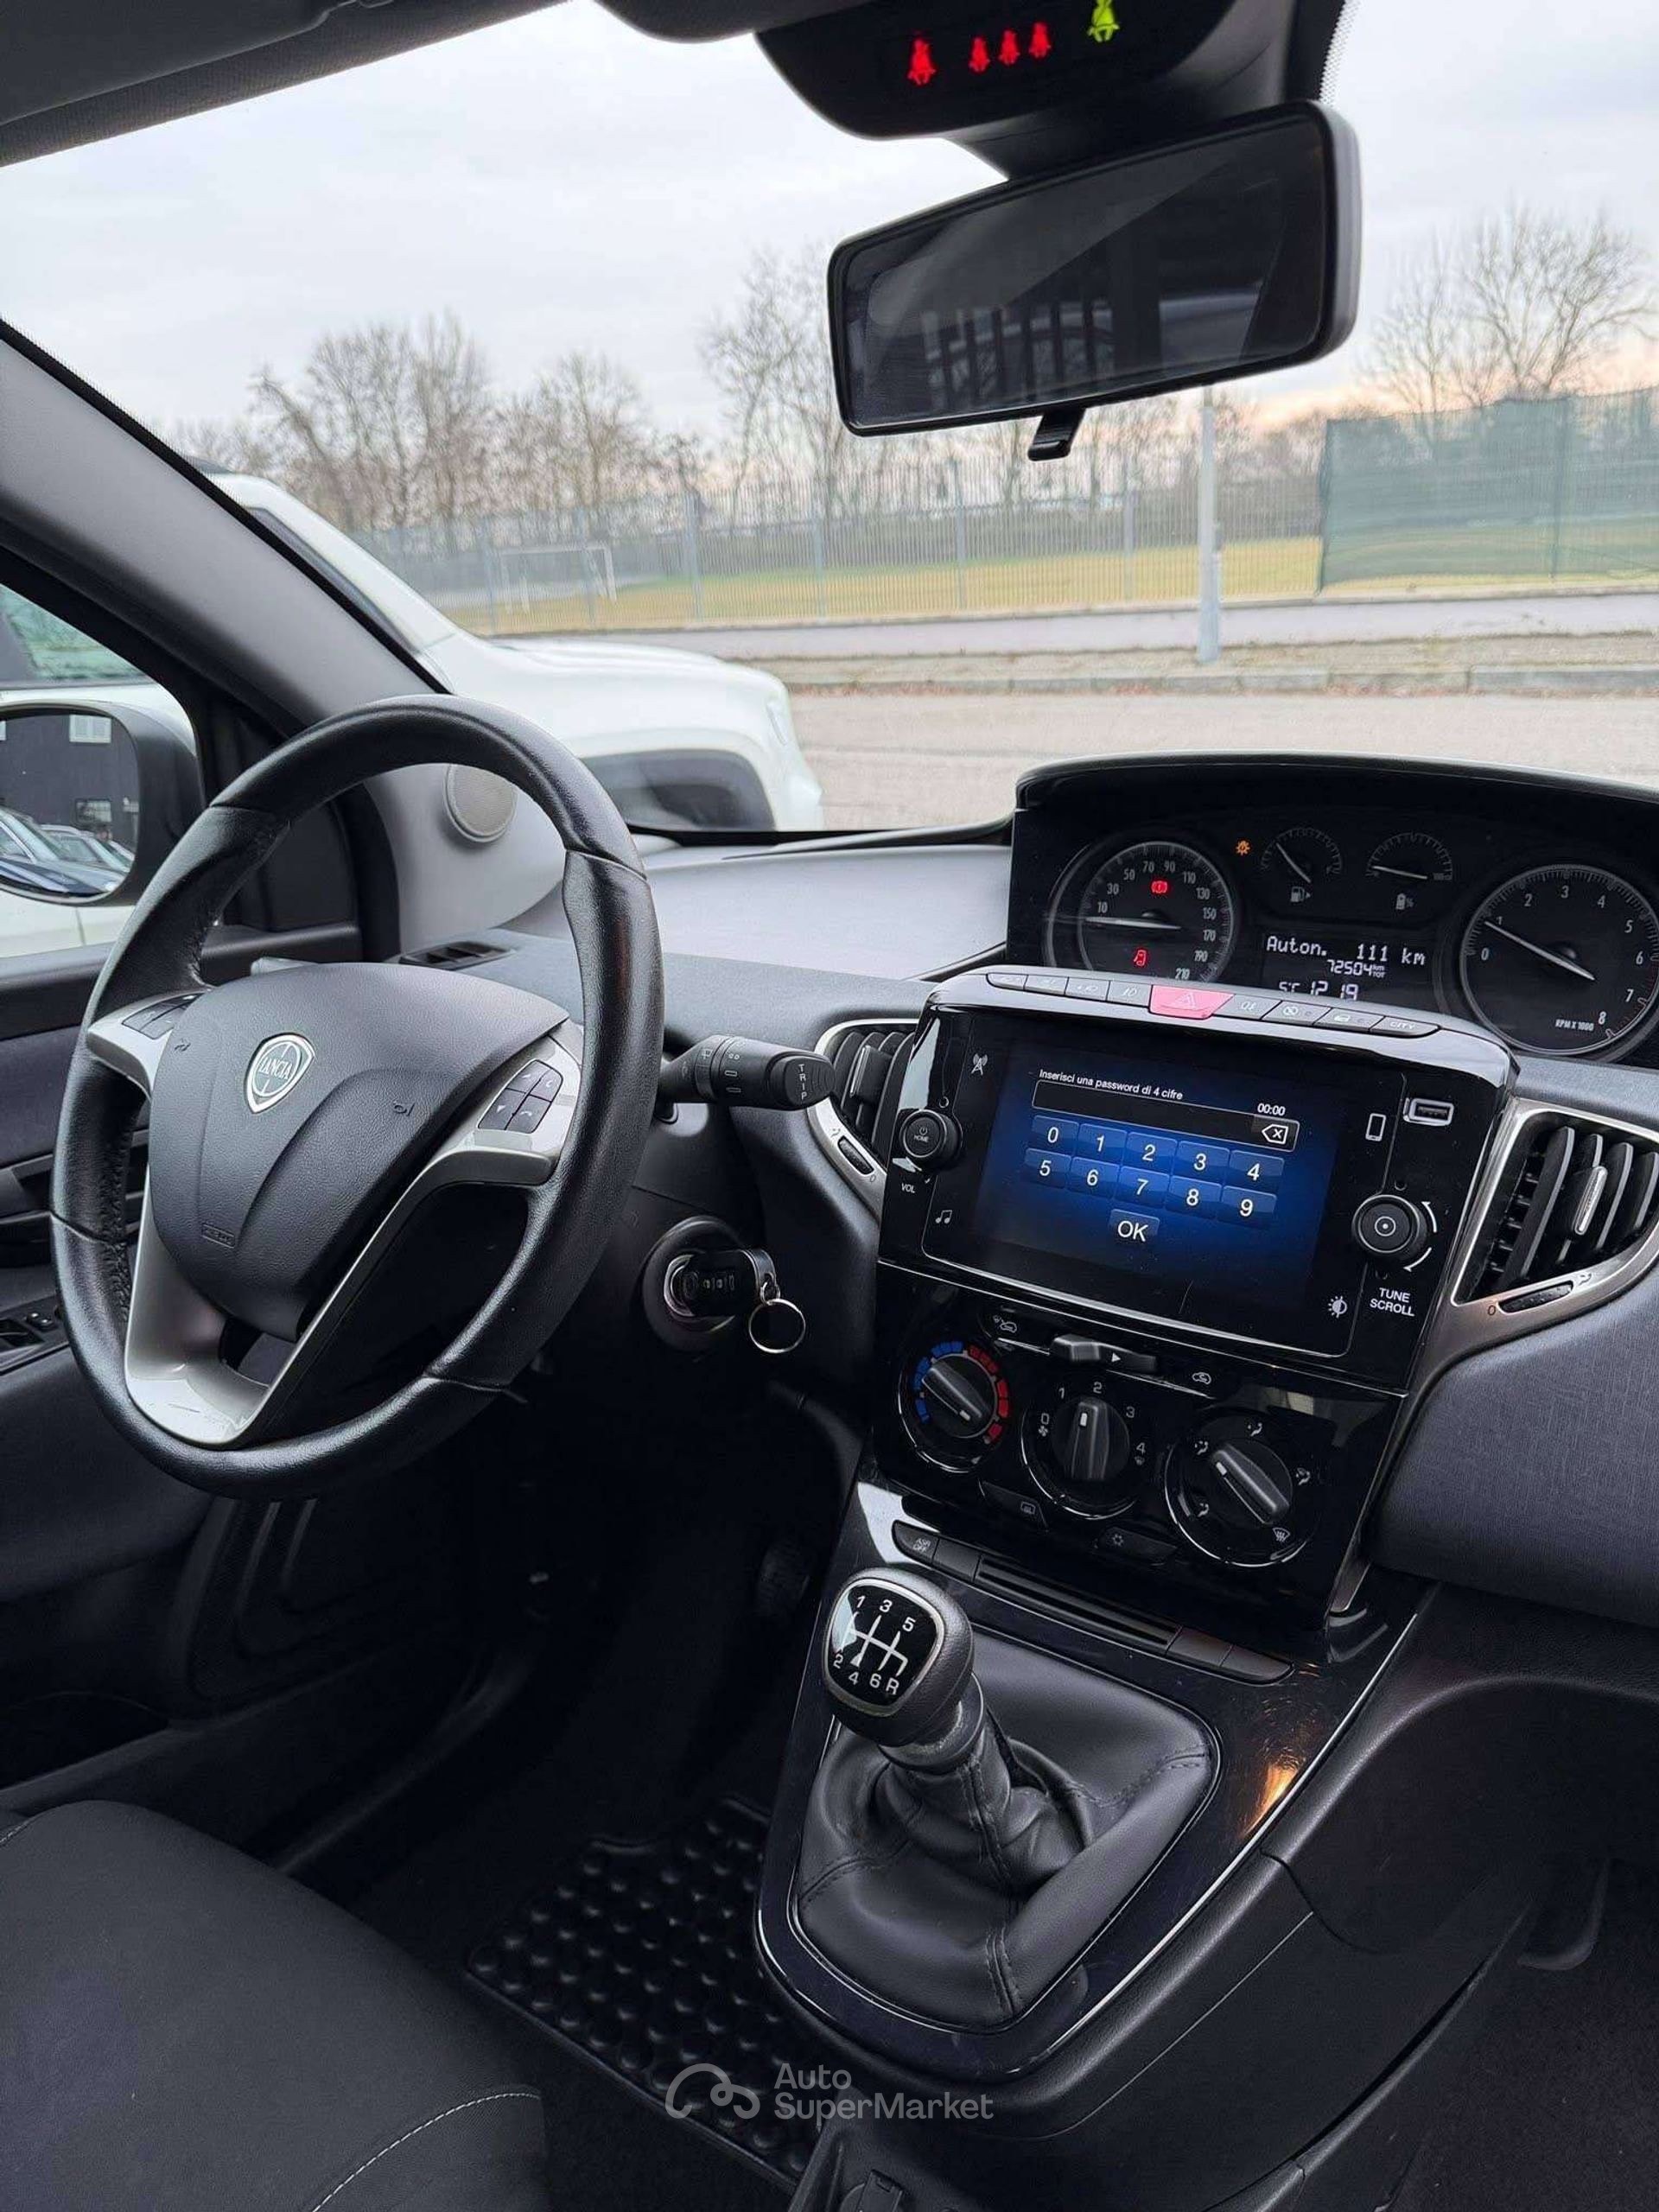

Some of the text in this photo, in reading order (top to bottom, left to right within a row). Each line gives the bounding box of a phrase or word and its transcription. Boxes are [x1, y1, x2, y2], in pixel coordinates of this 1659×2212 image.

[1142, 861, 1154, 873] 70
[1164, 861, 1175, 873] 90
[1123, 869, 1135, 880] 50
[1183, 872, 1196, 884] 110
[1107, 883, 1119, 895] 30
[1196, 887, 1210, 899] 130
[1561, 886, 1569, 899] 3
[1524, 893, 1533, 906] 2
[1598, 895, 1605, 908] 4
[1097, 901, 1108, 913] 10
[1203, 908, 1217, 920] 150
[1624, 919, 1633, 933] 5
[1203, 930, 1216, 942] 170
[1194, 950, 1208, 963] 190
[1267, 936, 1426, 966] Auton. 111 km
[1481, 948, 1490, 961] 0
[1636, 951, 1643, 964] 6
[1175, 968, 1191, 980] 210
[1327, 959, 1372, 977] 72504
[1625, 988, 1634, 1002] 7
[1599, 1011, 1606, 1025] 8
[1390, 1020, 1415, 1031] CITY
[1555, 1019, 1571, 1029] RPM
[1578, 1021, 1594, 1032] 1000
[258, 1056, 293, 1080] LANCIA
[798, 1064, 807, 1100] TRIP
[1039, 1069, 1183, 1100] Inserisci una password di 4 cifre
[1257, 1103, 1286, 1116] 00:00
[1047, 1127, 1262, 1180] 0 1 2 3 4
[901, 1183, 916, 1193] VOL
[1039, 1160, 1254, 1217] 5 6 7 8 9
[1117, 1220, 1149, 1243] OK
[1378, 1287, 1411, 1303] TUNE
[1370, 1298, 1415, 1317] SCROLL
[1058, 1388, 1065, 1399] 1
[1093, 1382, 1103, 1394] 2
[1126, 1406, 1135, 1418] 3
[1040, 1413, 1050, 1425] 0
[1136, 1442, 1146, 1454] 4
[856, 1595, 866, 1608] 1
[879, 1599, 893, 1613] 3
[902, 1617, 916, 1631] 5
[833, 1654, 844, 1669] 2
[849, 1672, 860, 1685] 4
[869, 1674, 882, 1688] 6
[886, 1678, 899, 1694] R
